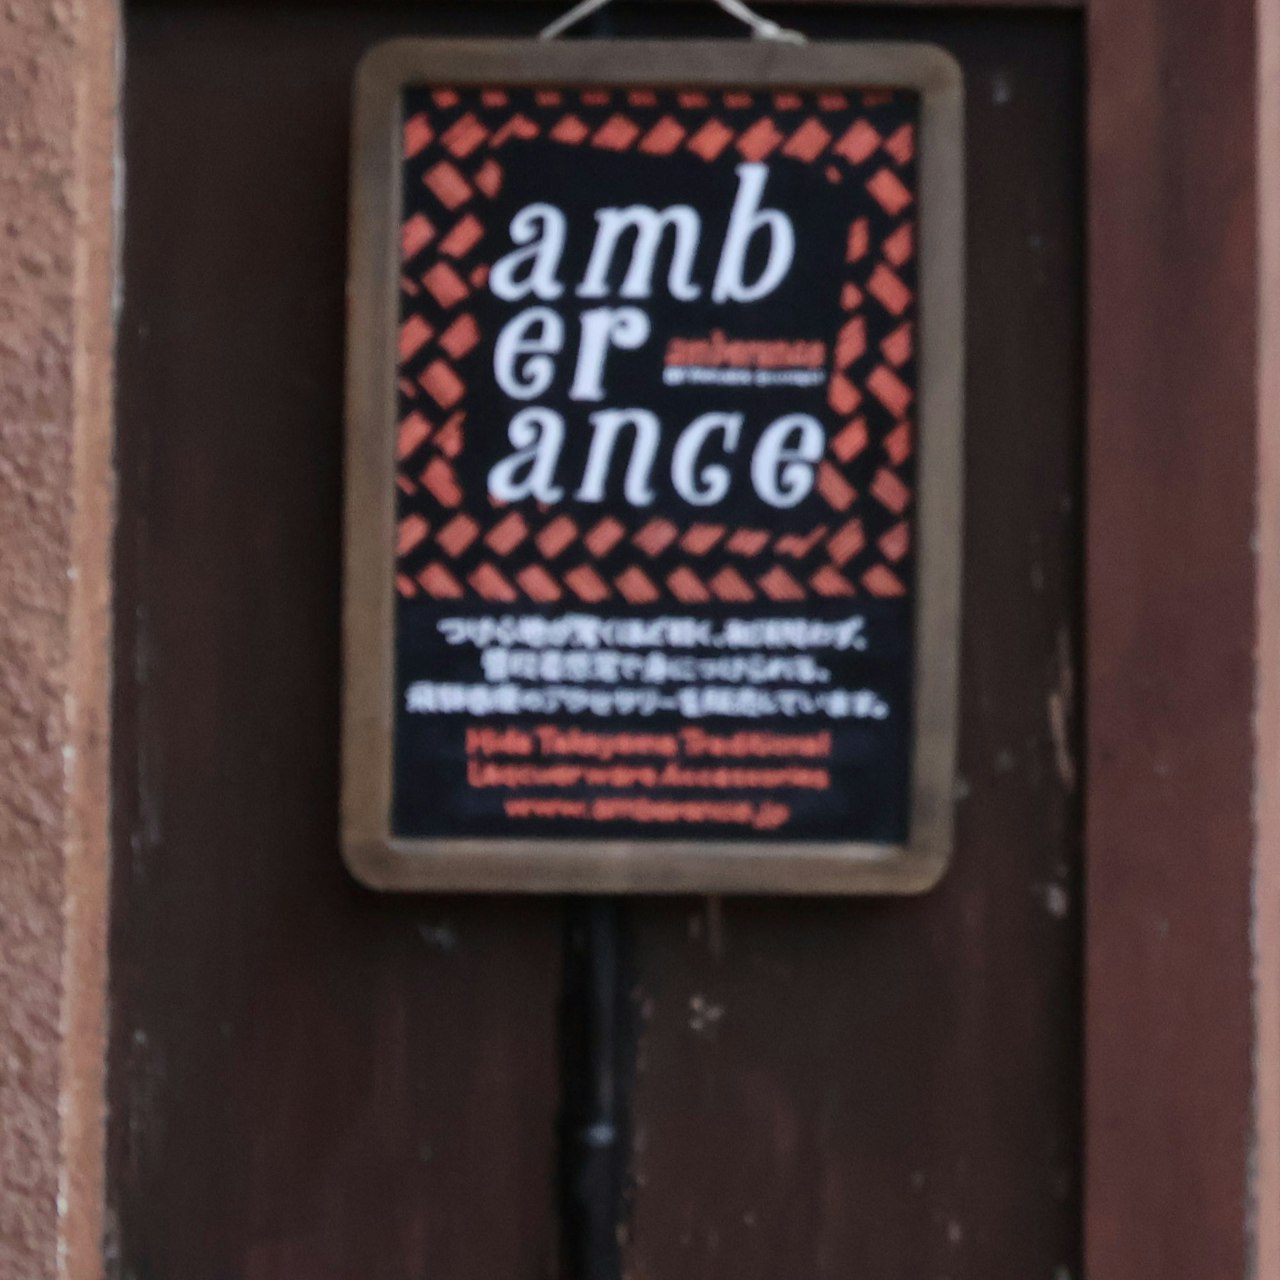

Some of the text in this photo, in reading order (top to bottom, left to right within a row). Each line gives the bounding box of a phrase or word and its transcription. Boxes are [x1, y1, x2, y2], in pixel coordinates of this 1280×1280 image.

[487, 162, 797, 303] amb
[493, 305, 650, 401] er
[486, 407, 826, 508] ance
